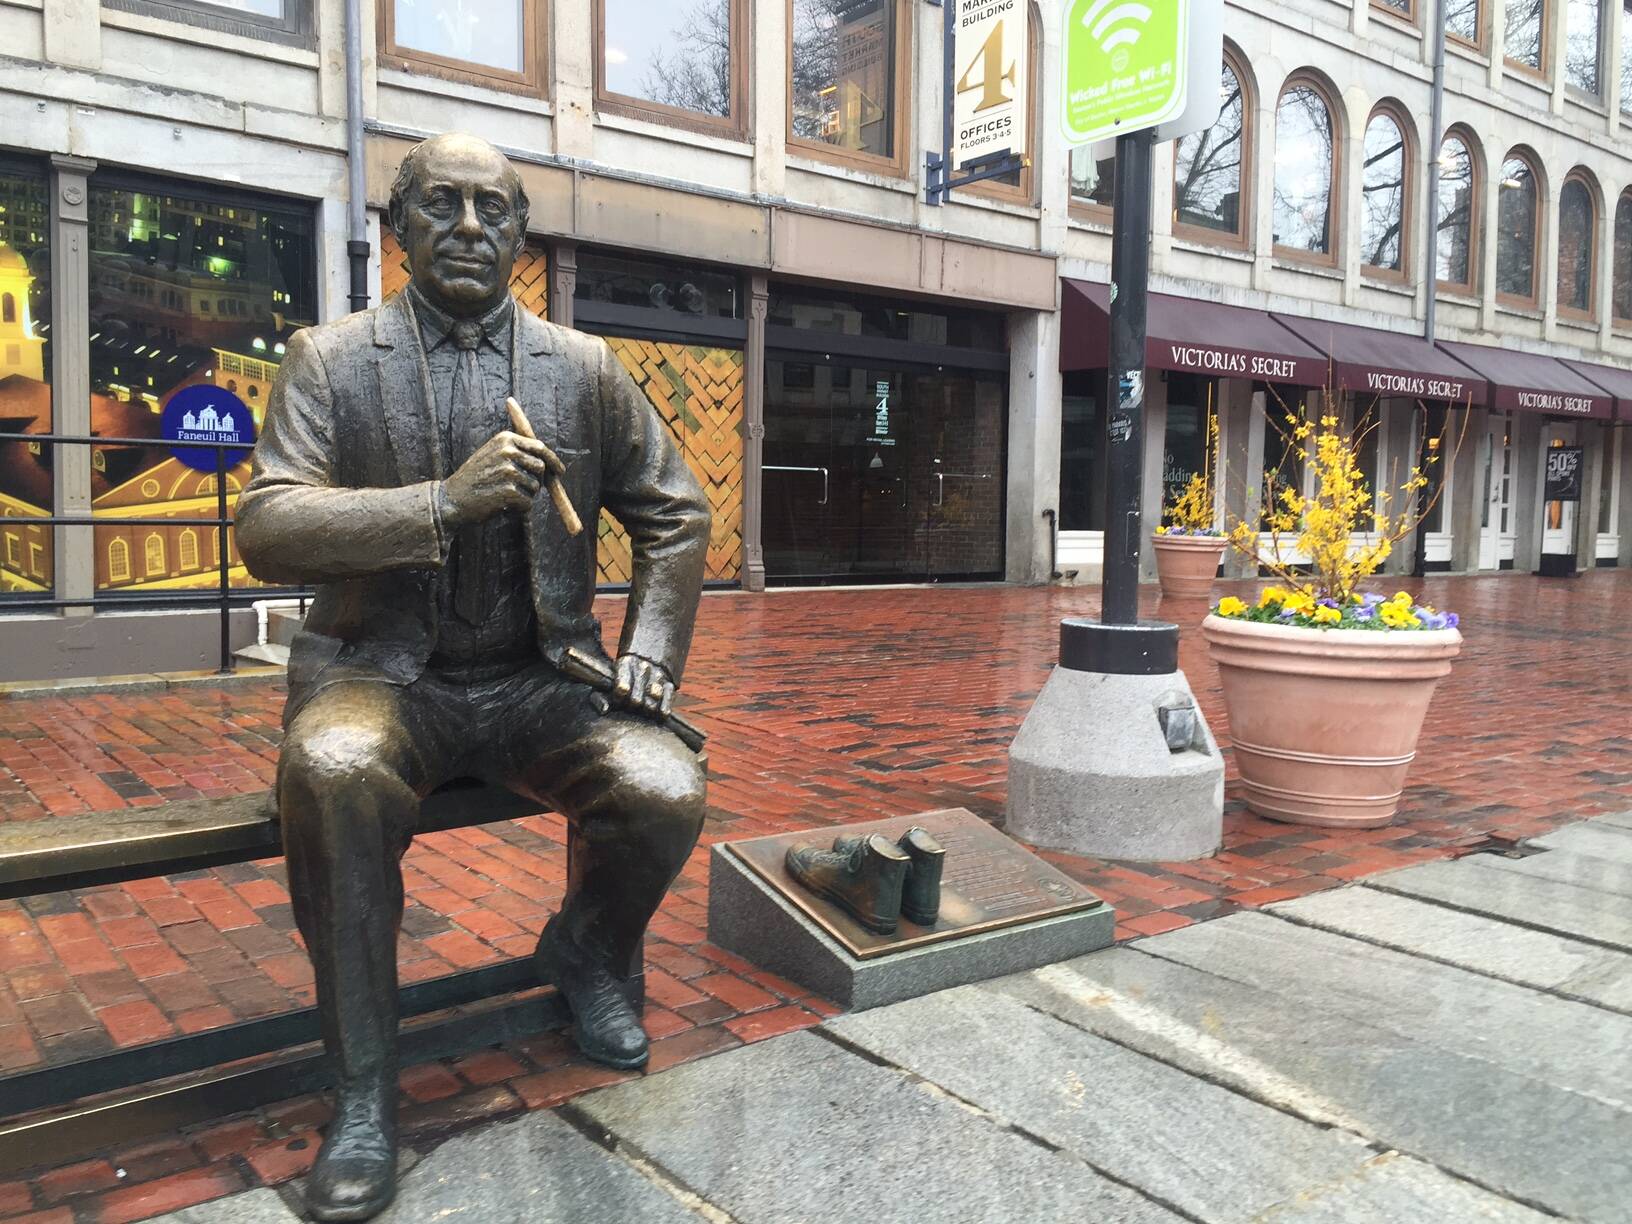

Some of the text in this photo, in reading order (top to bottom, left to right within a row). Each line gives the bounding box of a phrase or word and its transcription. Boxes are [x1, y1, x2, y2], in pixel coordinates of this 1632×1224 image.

[962, 0, 1014, 28] BUILDING
[957, 19, 1016, 113] 4
[1070, 79, 1109, 104] Wicked
[960, 116, 1012, 140] OFFICES
[960, 135, 991, 150] FLOORS
[1171, 346, 1297, 378] VICTORIA'S SECRET
[1367, 373, 1463, 398] VICTORIA'S SECRET
[876, 397, 889, 415] 4
[1518, 392, 1593, 413] VICTORIA'S SECRET
[177, 430, 240, 443] Faneuil Hall
[1547, 451, 1578, 472] 50%
